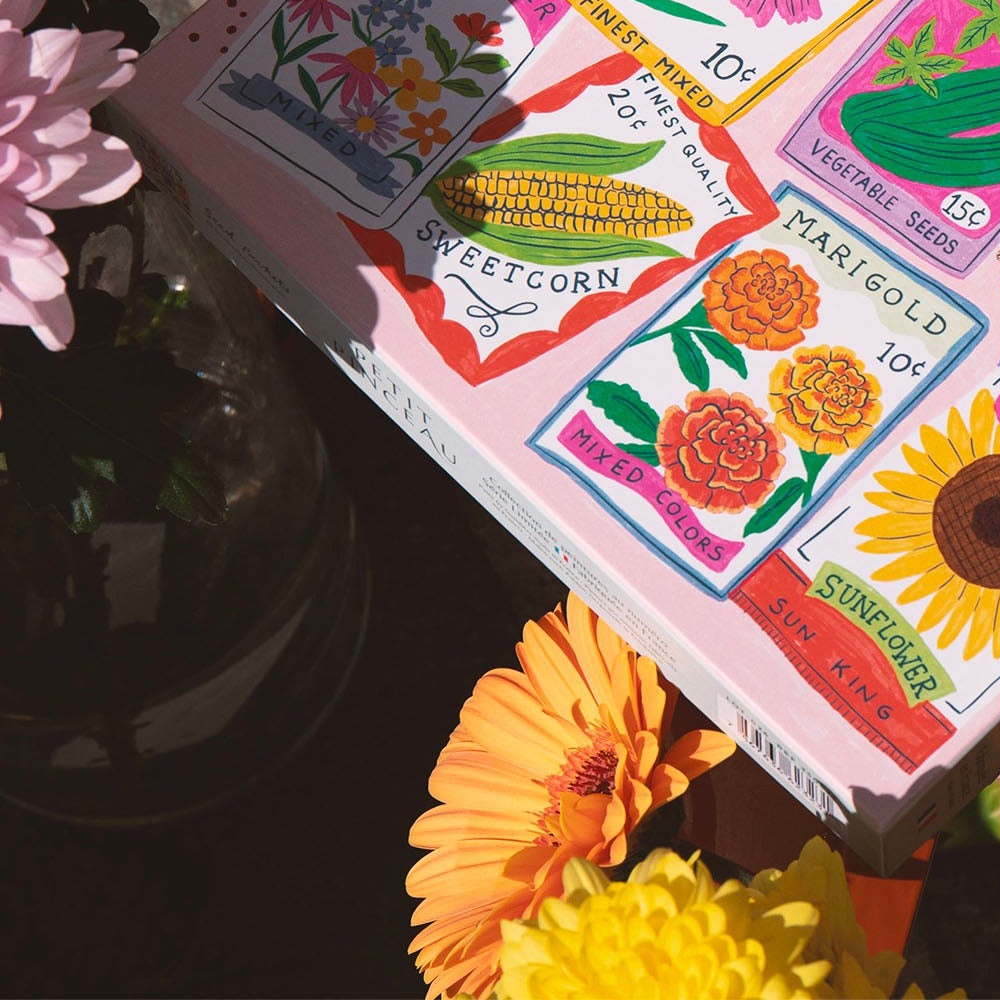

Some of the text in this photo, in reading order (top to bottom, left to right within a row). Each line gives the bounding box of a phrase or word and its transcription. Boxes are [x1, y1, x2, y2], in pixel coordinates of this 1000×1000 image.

[654, 56, 713, 109] MIXED
[700, 43, 758, 82] 10¢
[270, 91, 357, 157] MIXED
[607, 88, 648, 130] 20¢
[636, 68, 738, 217] FINEST QUALITY
[810, 138, 959, 255] VEGETABLE SEEDS
[942, 194, 988, 228] 15¢
[417, 219, 620, 294] SWEETCORN
[782, 209, 947, 336] MARIGOLD
[354, 346, 433, 425] PETIT
[876, 341, 927, 377] 10¢
[570, 428, 725, 562] MIXED COLORS
[769, 597, 816, 642] SUN
[831, 658, 893, 721] KING
[815, 572, 938, 700] SUNFLOWER
